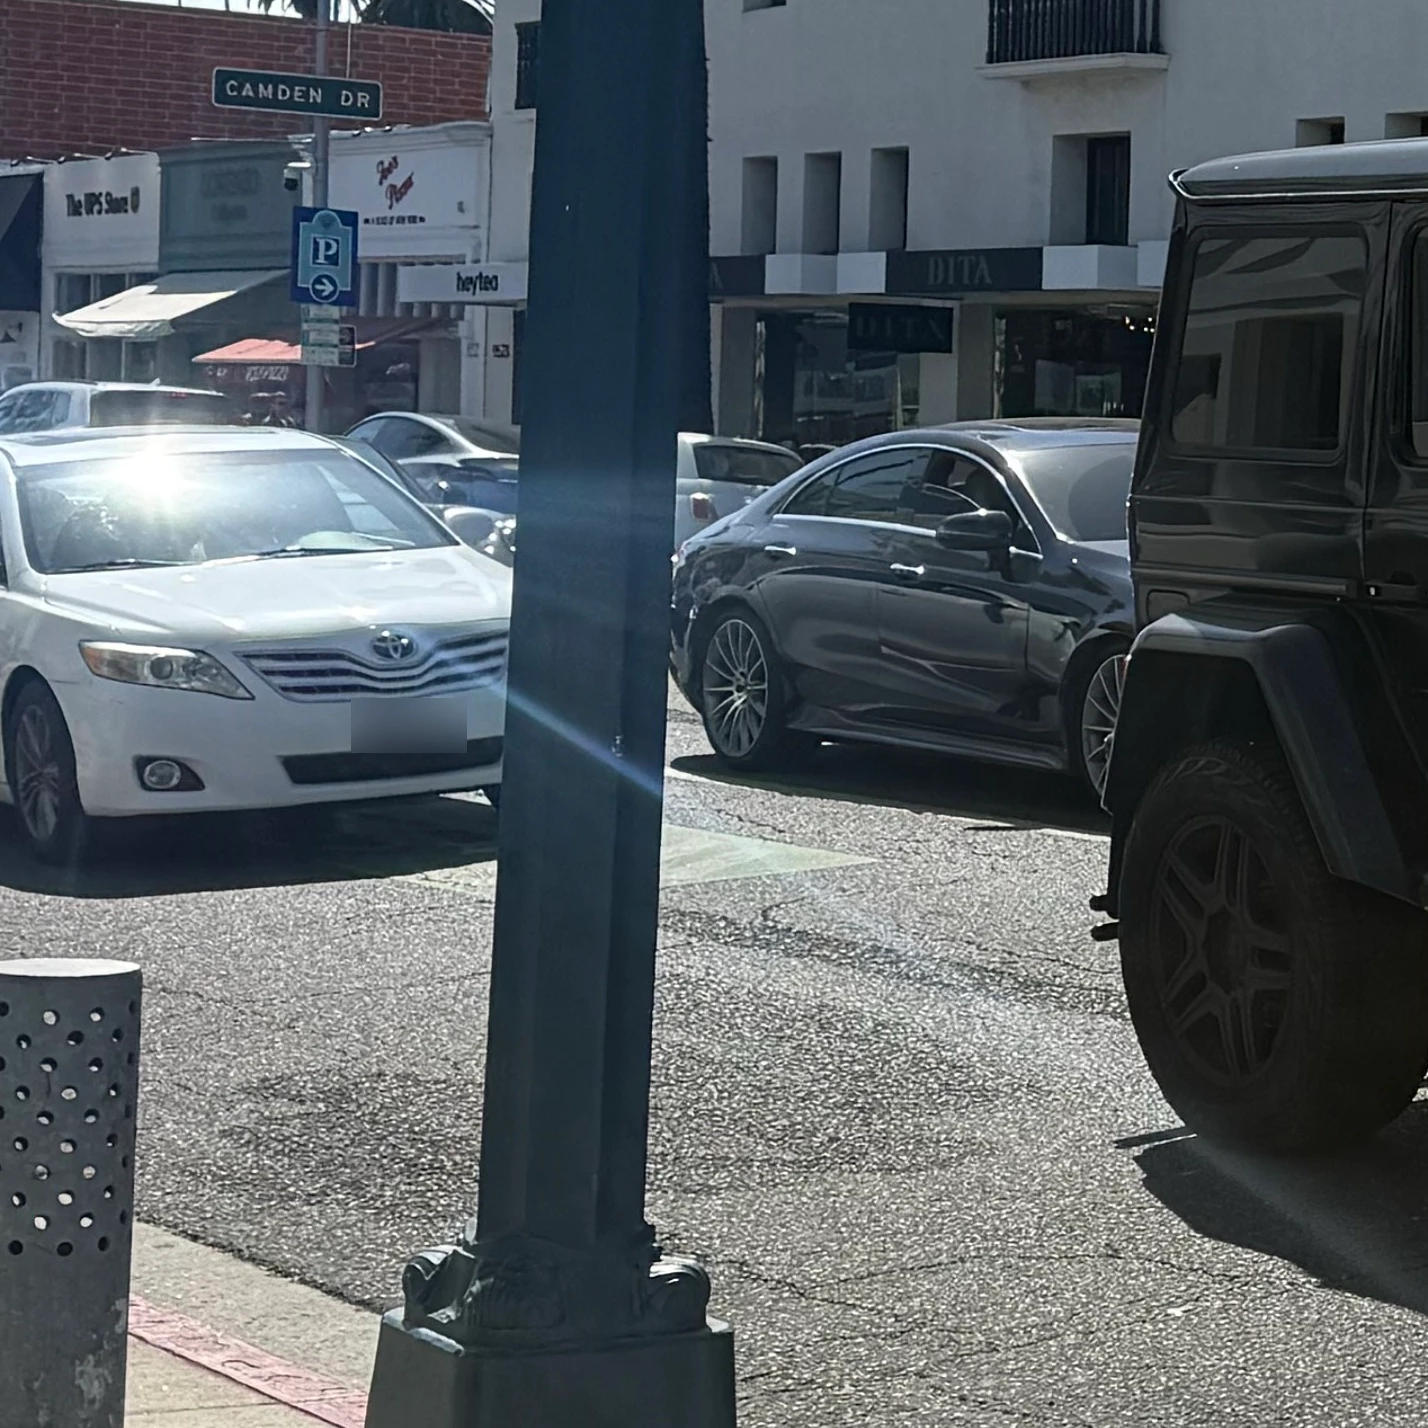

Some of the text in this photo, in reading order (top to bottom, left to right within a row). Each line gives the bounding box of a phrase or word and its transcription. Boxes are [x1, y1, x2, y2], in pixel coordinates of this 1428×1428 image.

[225, 79, 371, 109] CAMDEN DR
[66, 193, 83, 217] The
[84, 192, 104, 216] UPS
[314, 237, 339, 265] P
[456, 271, 499, 296] heytea
[926, 255, 993, 286] DITA
